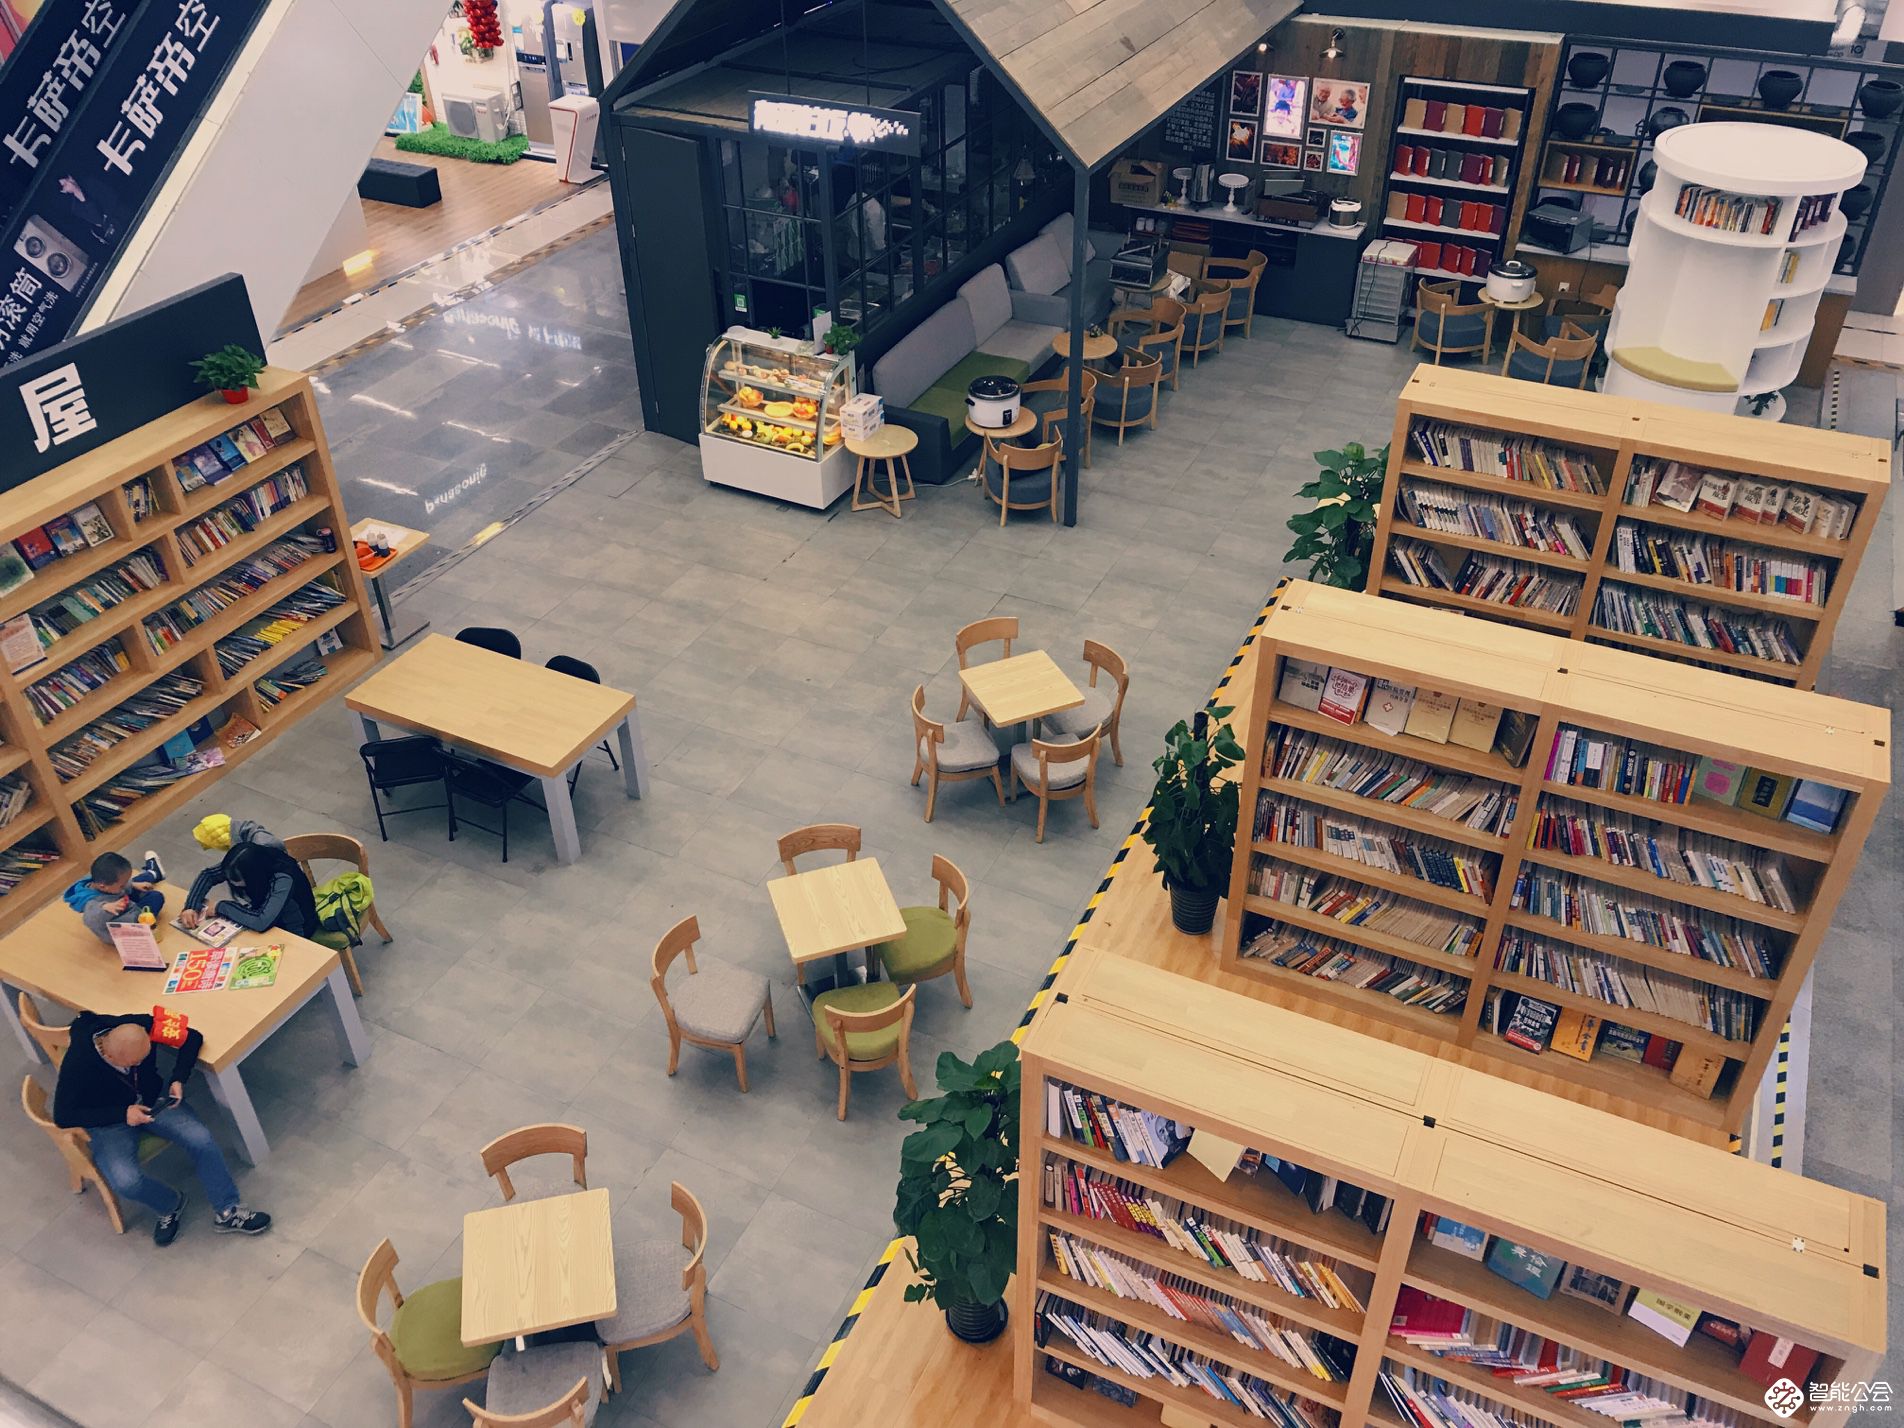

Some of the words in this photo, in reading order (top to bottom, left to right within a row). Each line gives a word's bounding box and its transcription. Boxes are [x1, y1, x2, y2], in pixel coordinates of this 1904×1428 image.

[97, 0, 220, 176] 卡萨帝空
[18, 290, 59, 349] 就用空气洗
[19, 362, 98, 453] 屋
